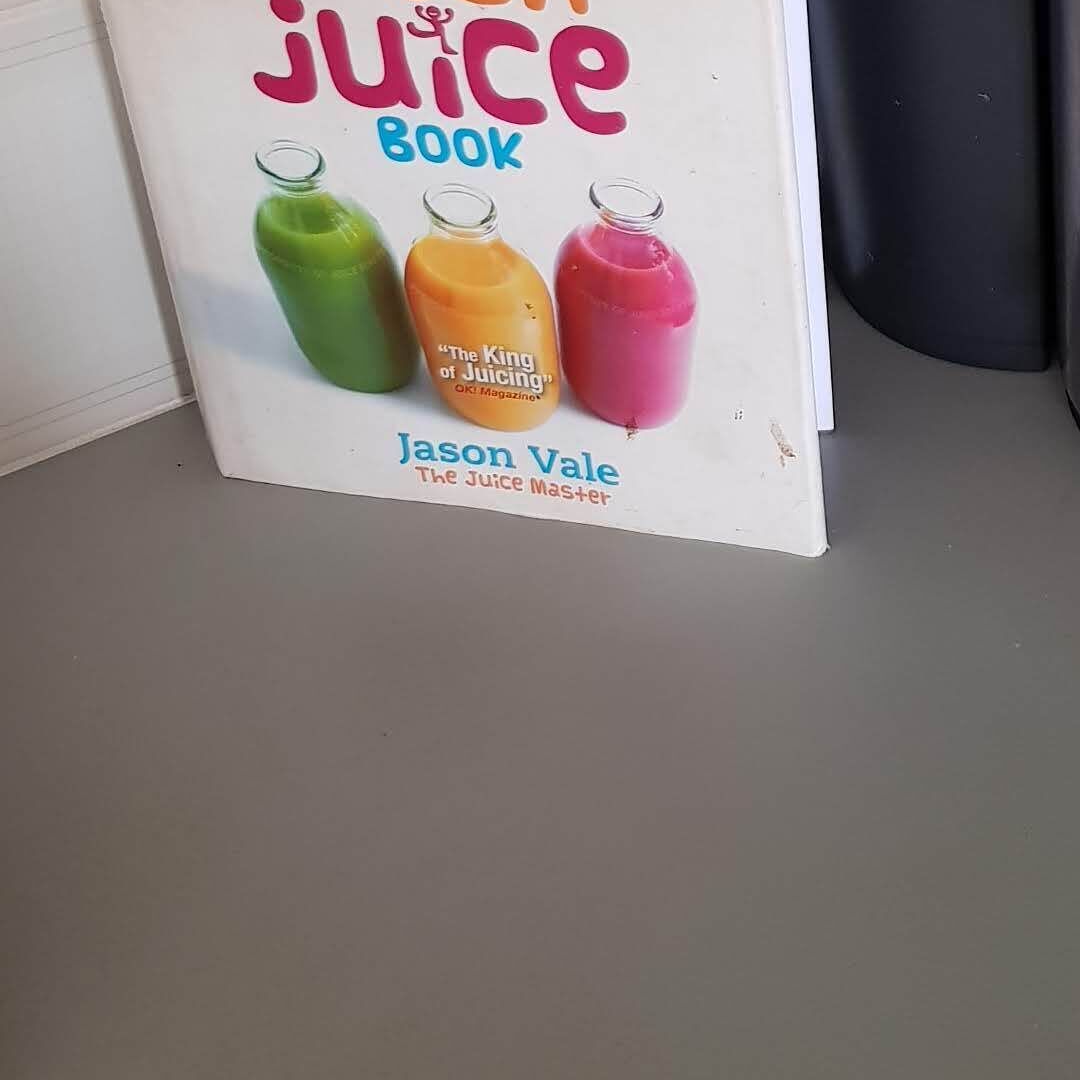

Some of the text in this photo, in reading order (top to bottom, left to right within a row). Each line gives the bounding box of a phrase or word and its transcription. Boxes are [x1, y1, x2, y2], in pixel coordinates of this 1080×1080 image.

[377, 115, 523, 170] BOOK
[440, 365, 456, 379] of
[482, 344, 535, 373] King
[455, 383, 536, 402] OK! Magazine
[398, 433, 620, 486] Jason Vale
[415, 466, 612, 506] The Juice Master
